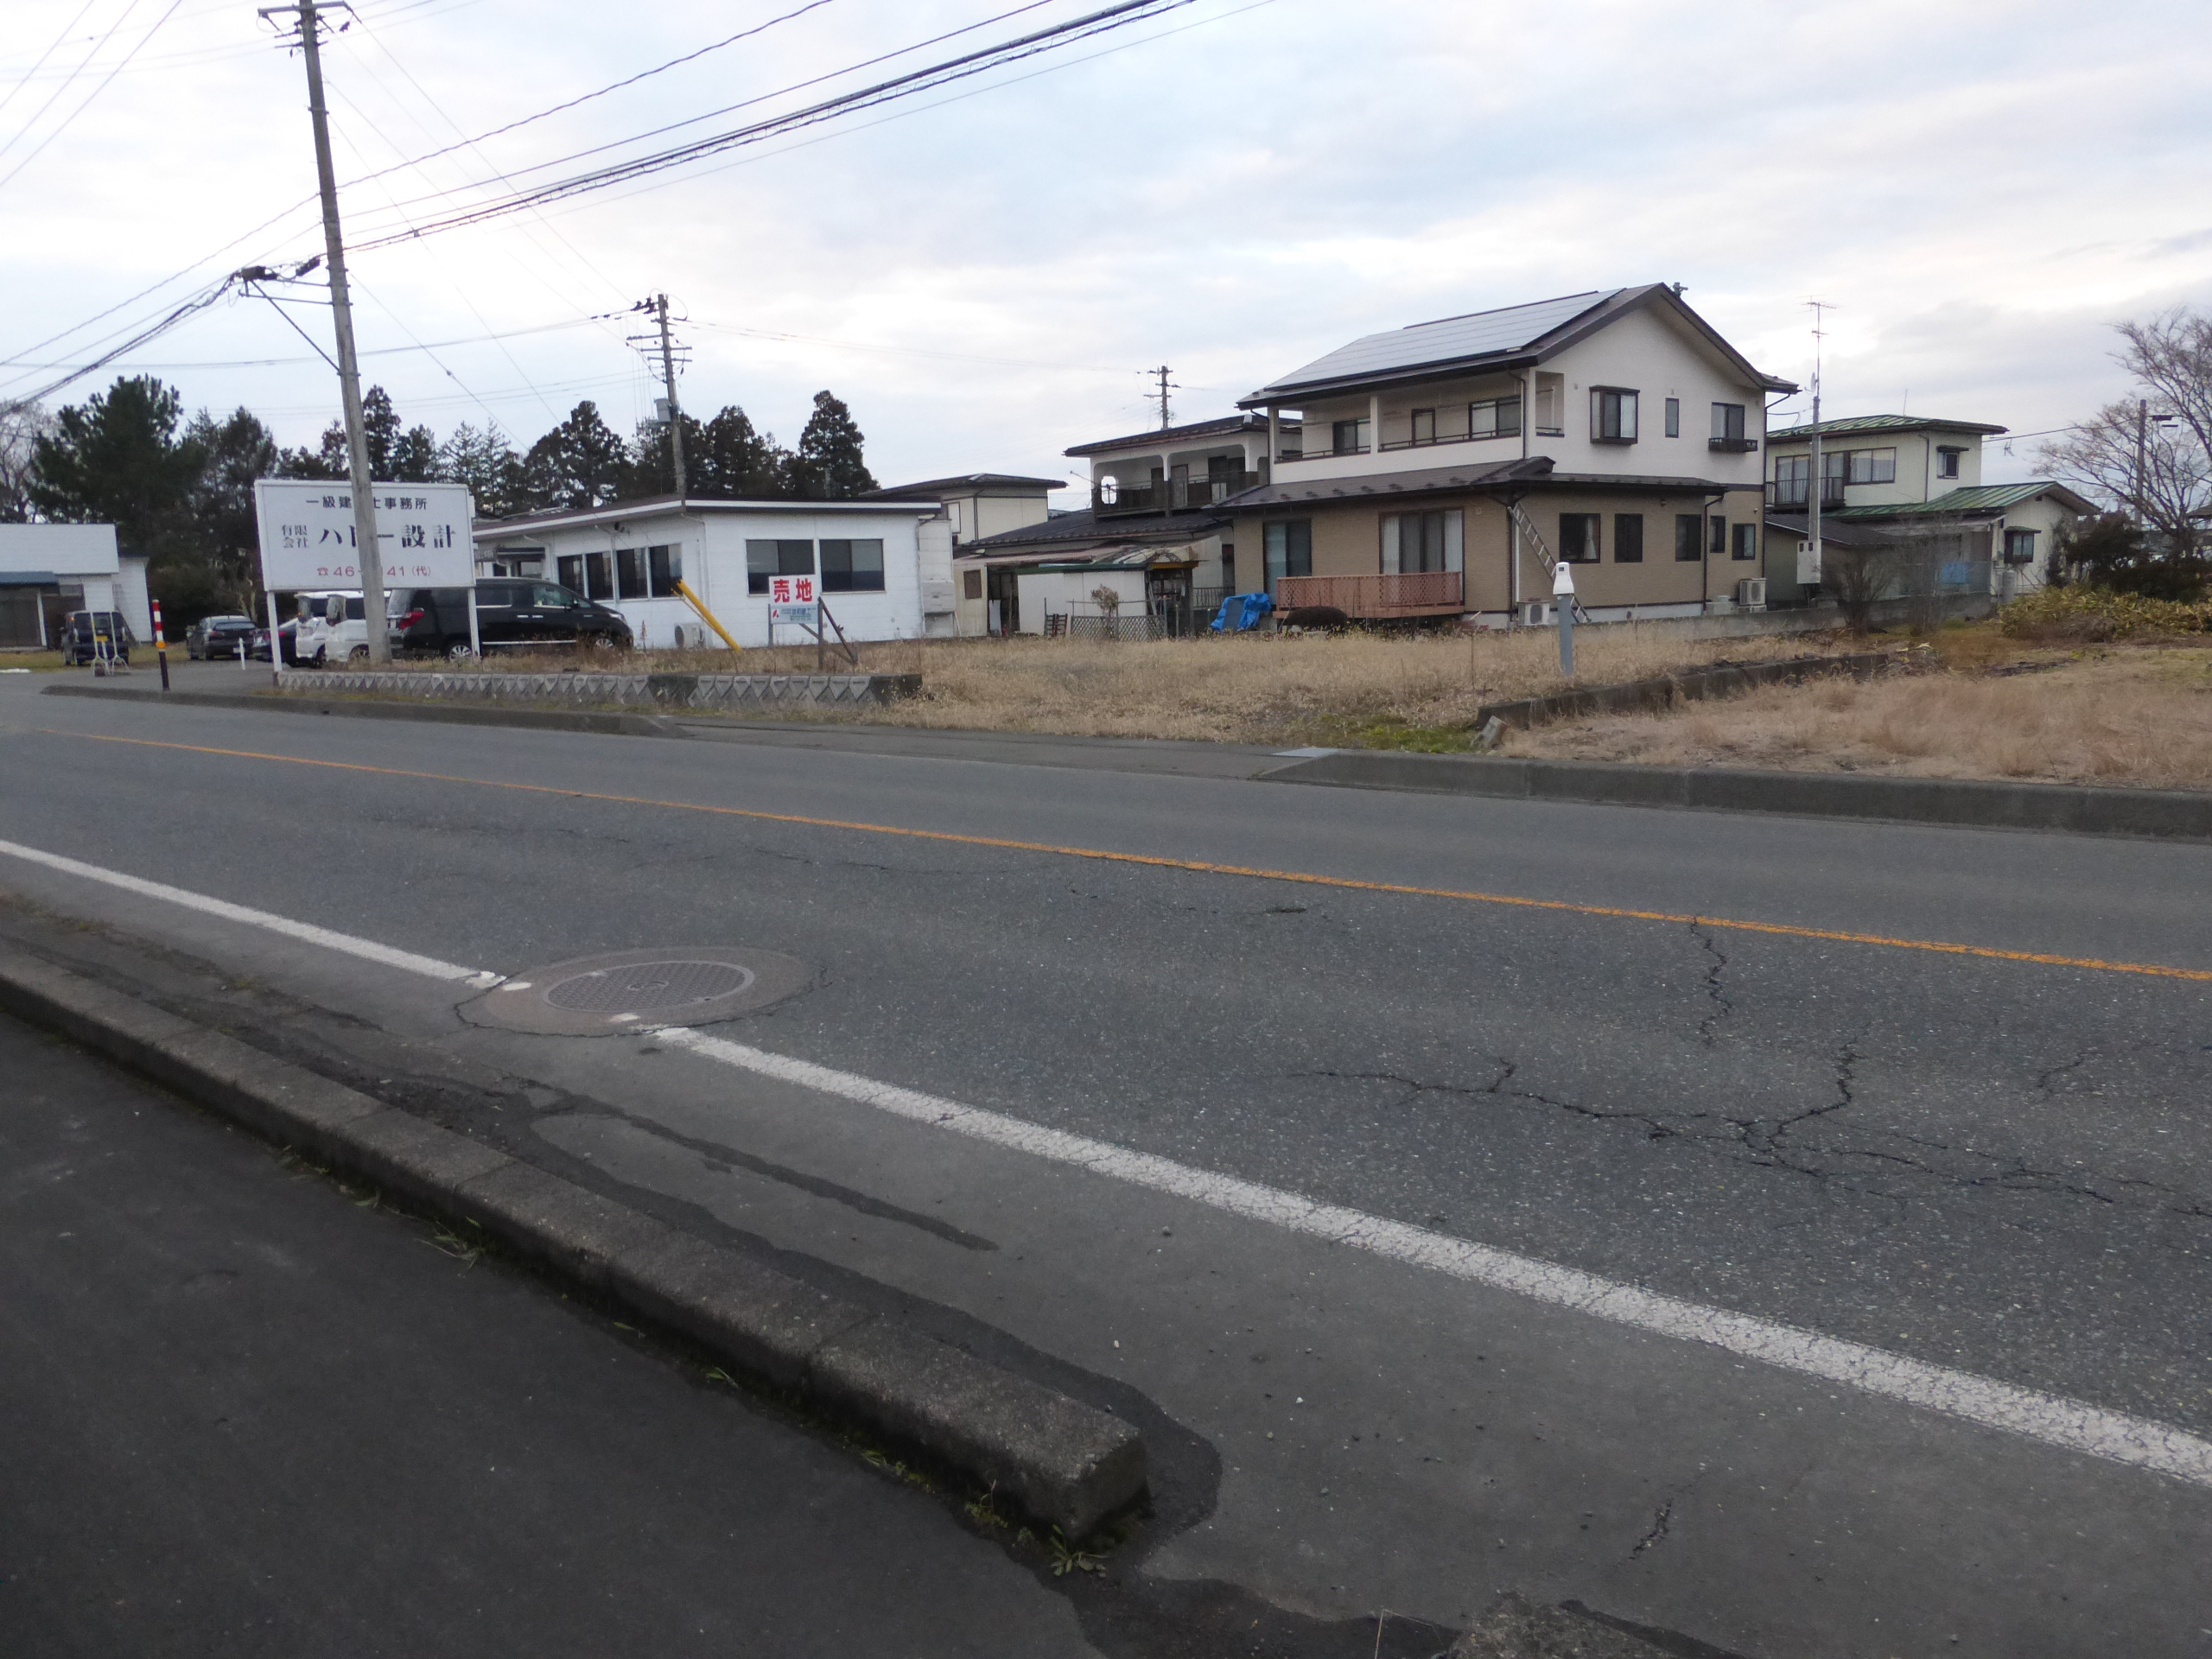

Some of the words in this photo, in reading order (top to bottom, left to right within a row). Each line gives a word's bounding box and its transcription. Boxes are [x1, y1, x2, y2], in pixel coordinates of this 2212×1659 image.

[306, 496, 428, 511] 一級建士事務所
[773, 577, 813, 603] 売地
